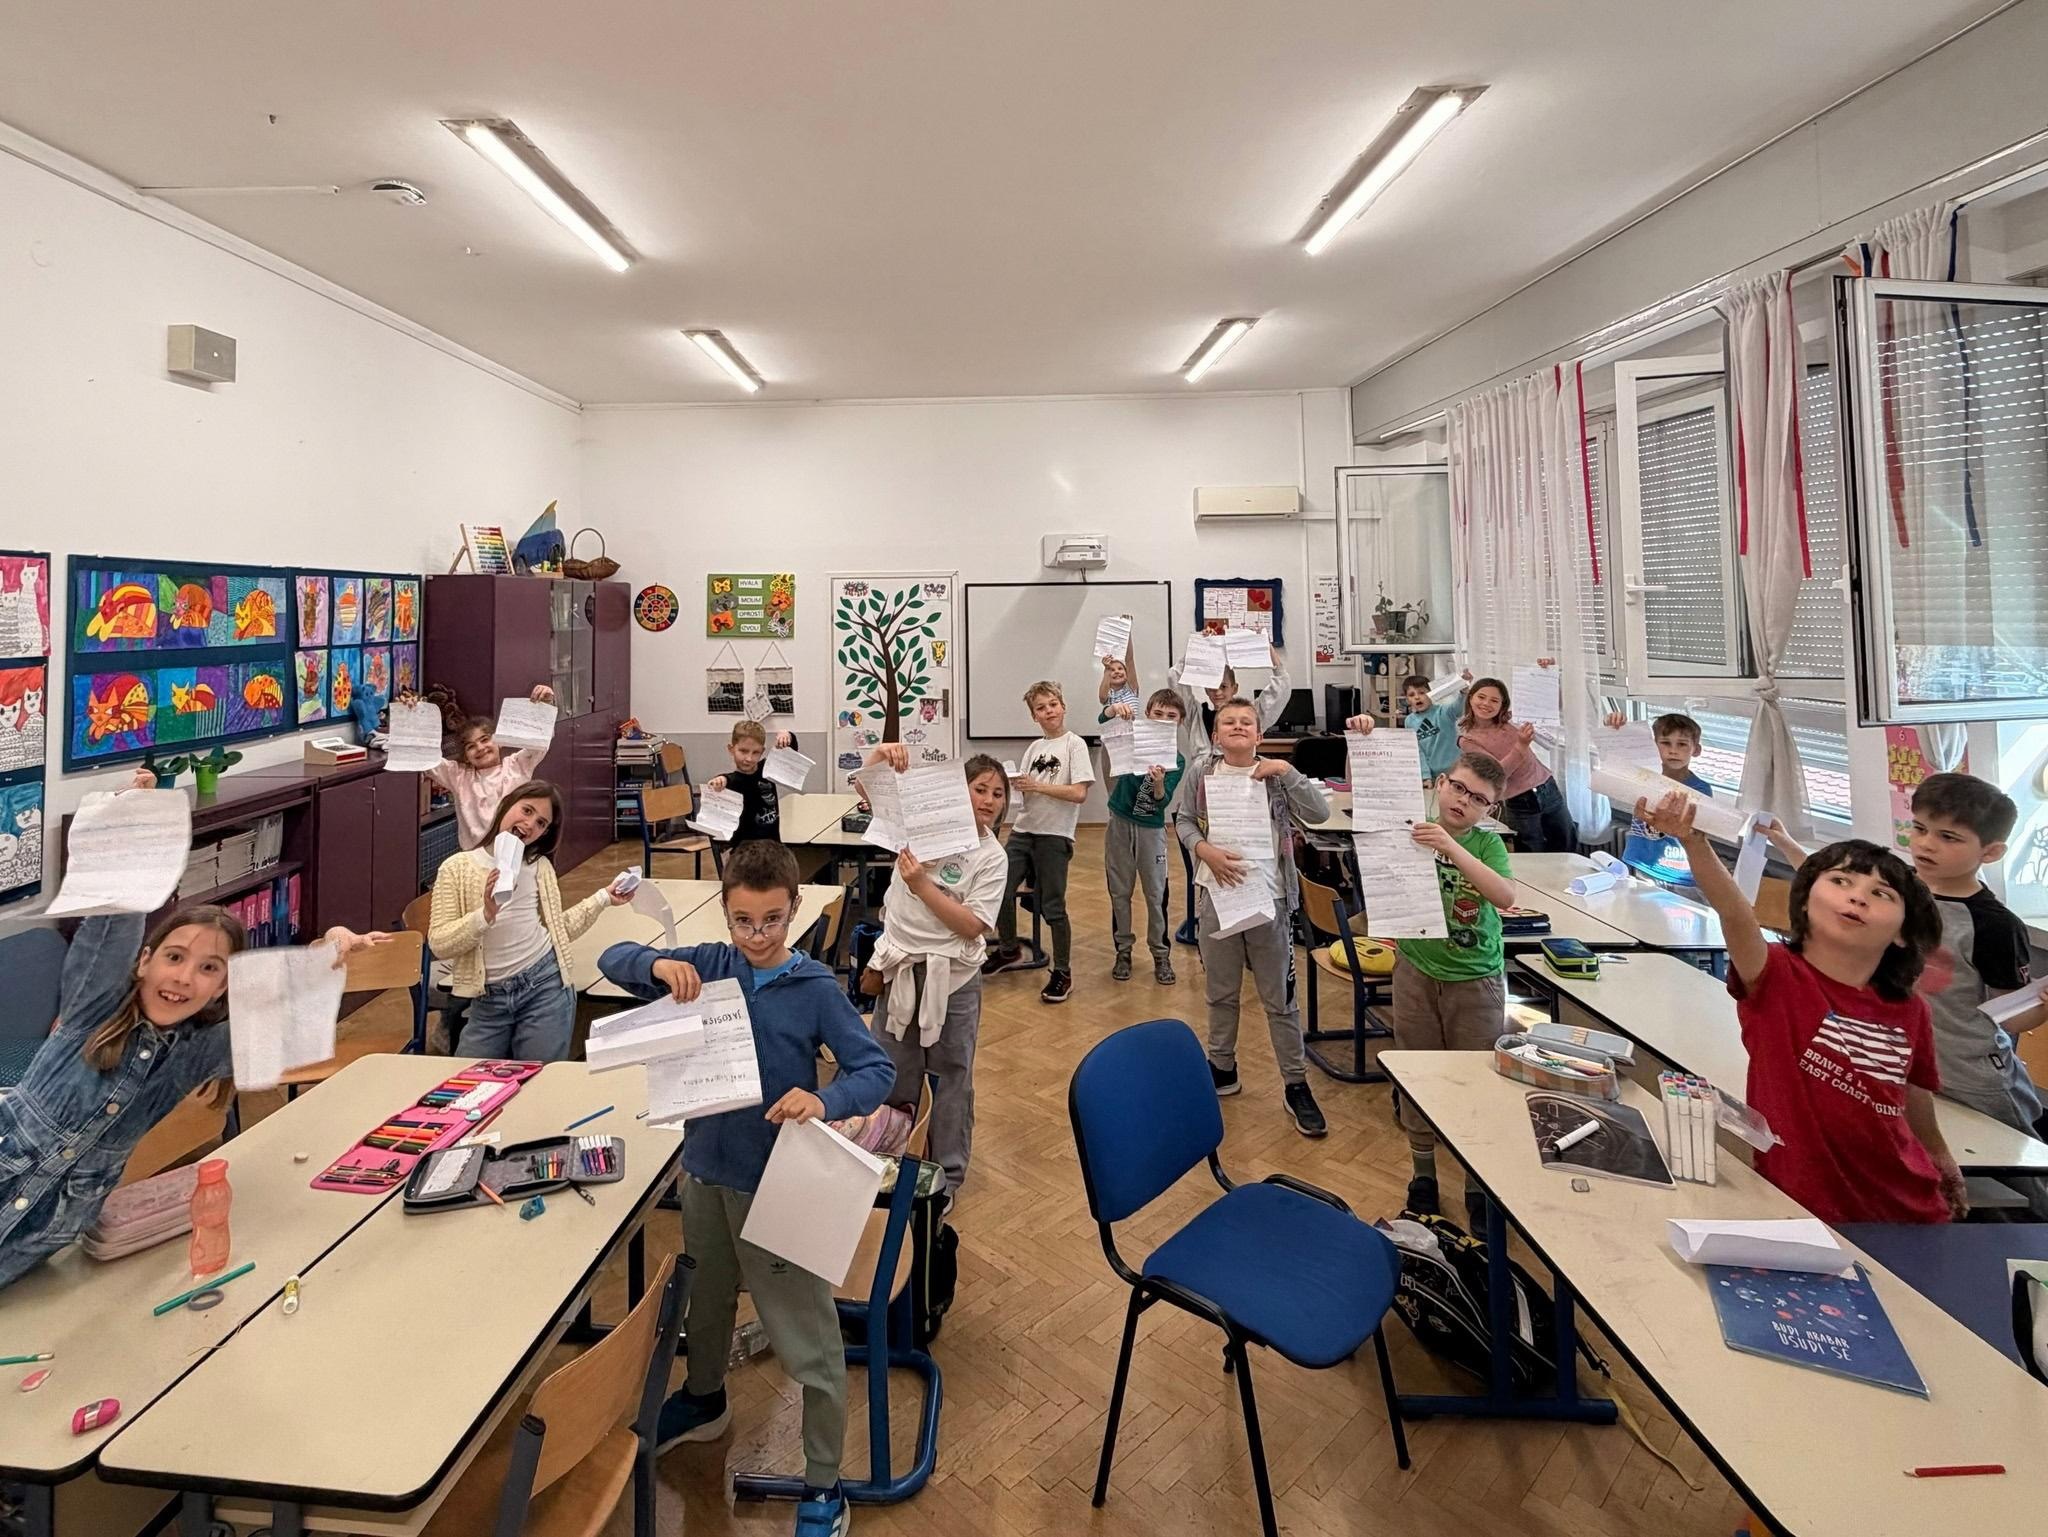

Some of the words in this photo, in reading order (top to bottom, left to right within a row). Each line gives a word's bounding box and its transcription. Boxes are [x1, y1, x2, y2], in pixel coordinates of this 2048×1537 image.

[1803, 1048, 1844, 1077] BRAVE
[1845, 1072, 1854, 1082] &
[1799, 1059, 1830, 1082] EAST
[1831, 1078, 1872, 1104] COAST
[1771, 1321, 1800, 1337] BUDI
[1778, 1332, 1826, 1355] USUDI
[1830, 1346, 1852, 1361] SE
